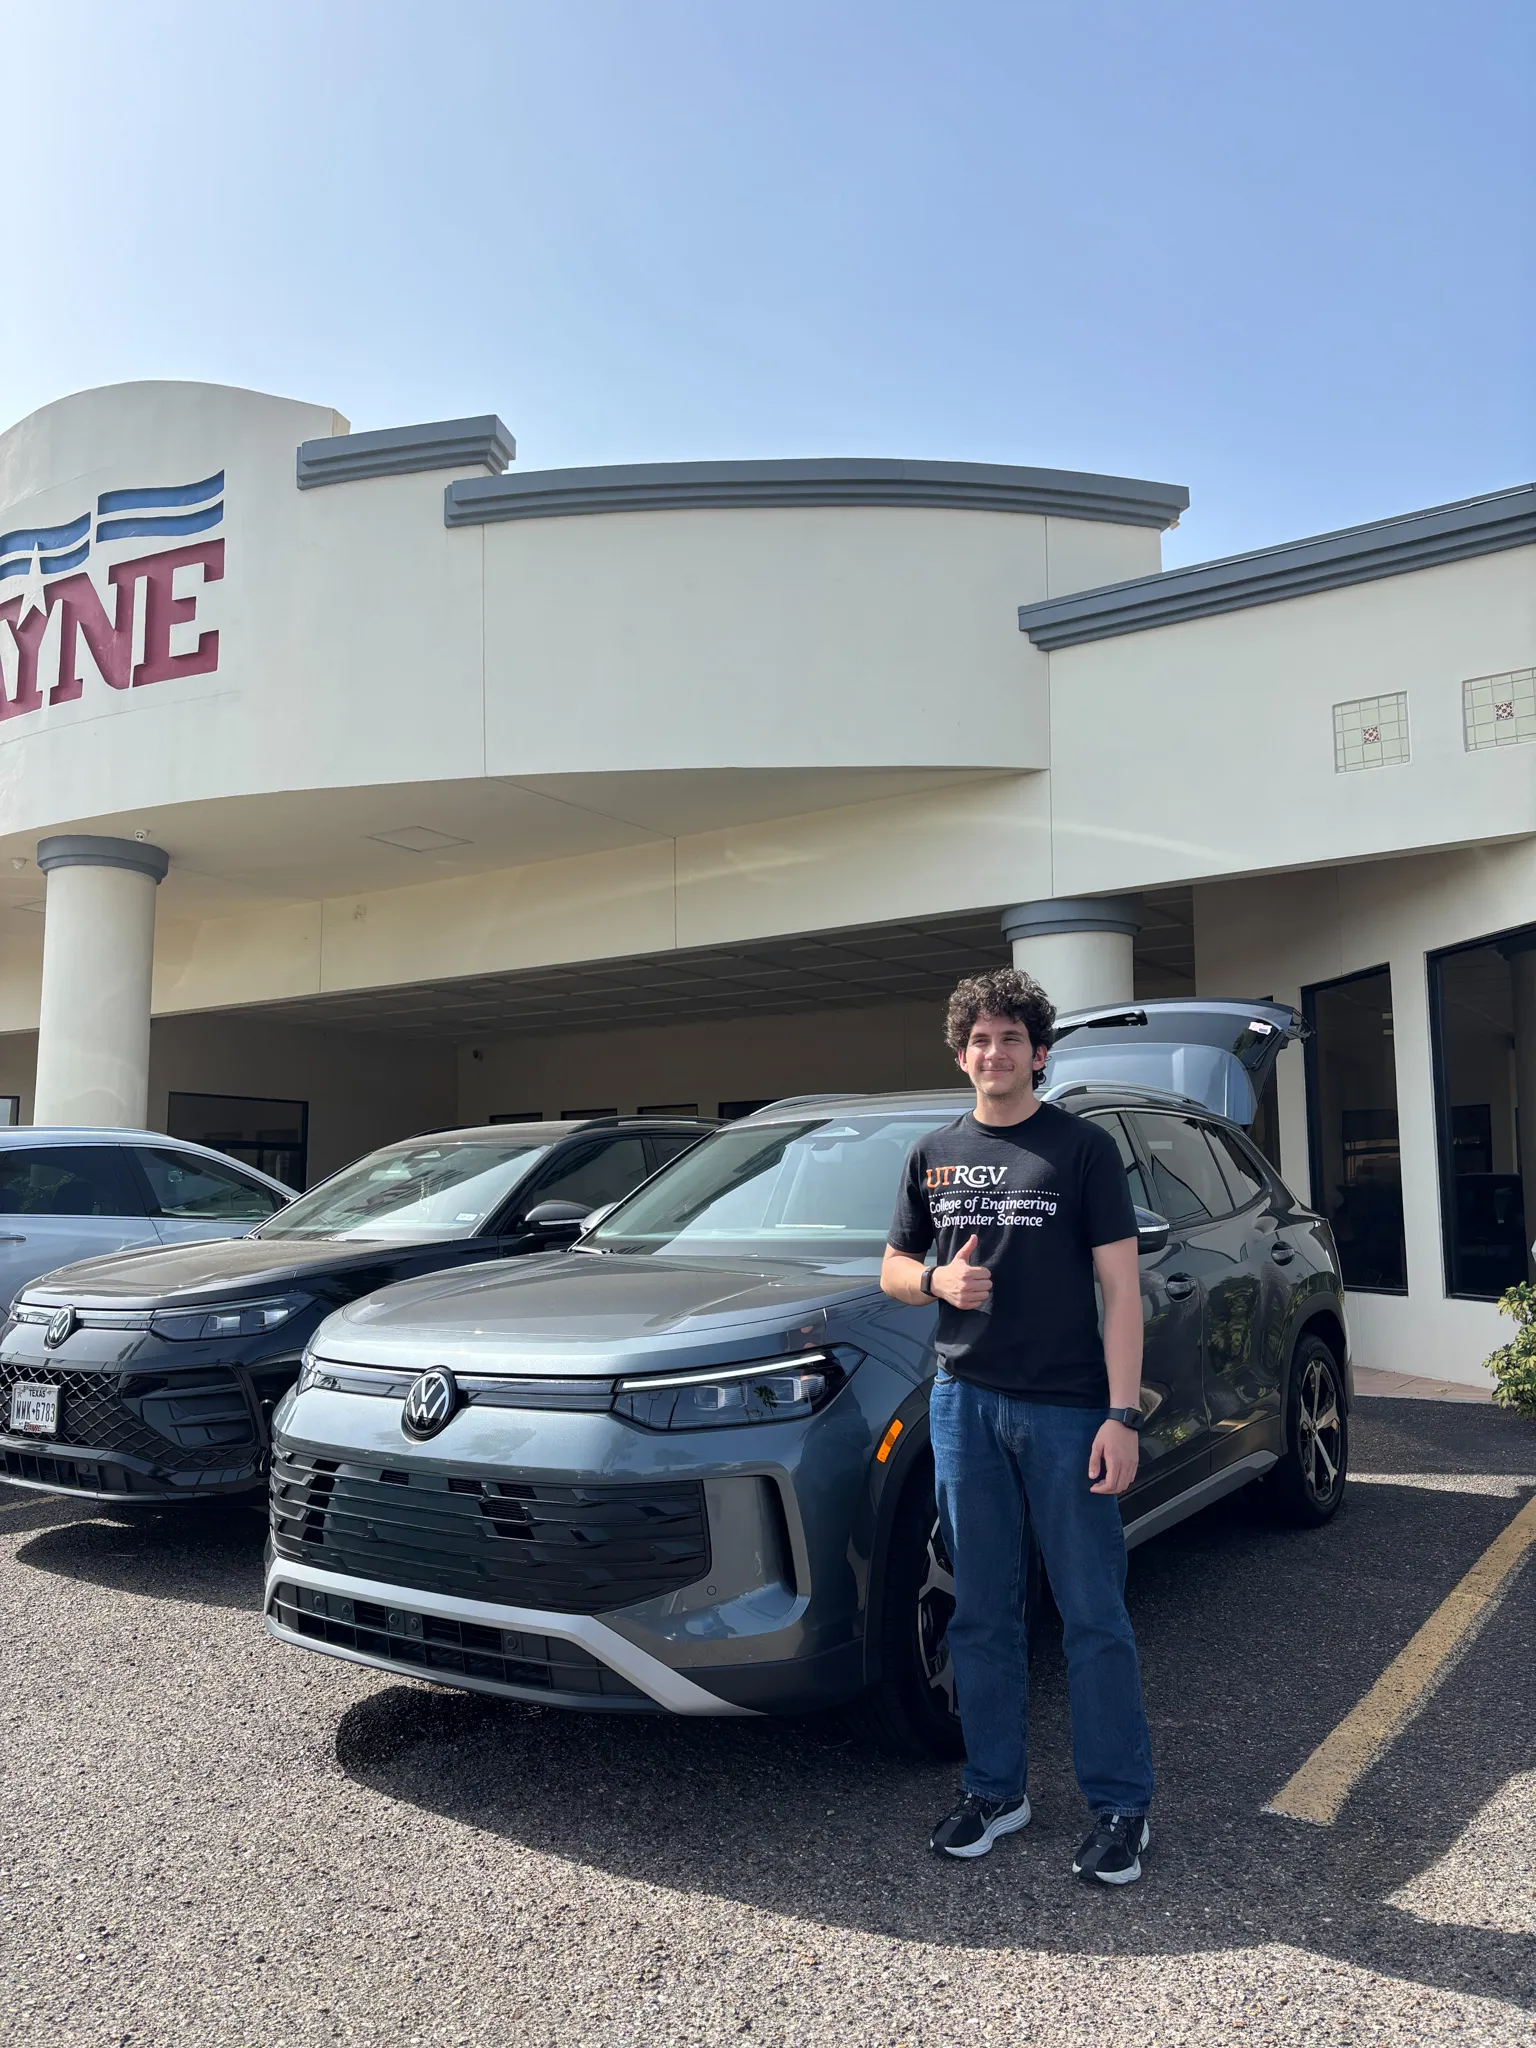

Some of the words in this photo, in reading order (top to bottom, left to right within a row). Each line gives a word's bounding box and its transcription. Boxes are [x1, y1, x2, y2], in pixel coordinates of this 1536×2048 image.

[926, 1165, 1008, 1189] UTRGV
[929, 1198, 961, 1214] College
[964, 1196, 979, 1212] of
[980, 1197, 1057, 1216] Engineering
[934, 1217, 942, 1228] &
[942, 1213, 995, 1229] Computer
[997, 1212, 1043, 1227] Science
[29, 1389, 46, 1398] TEXAS
